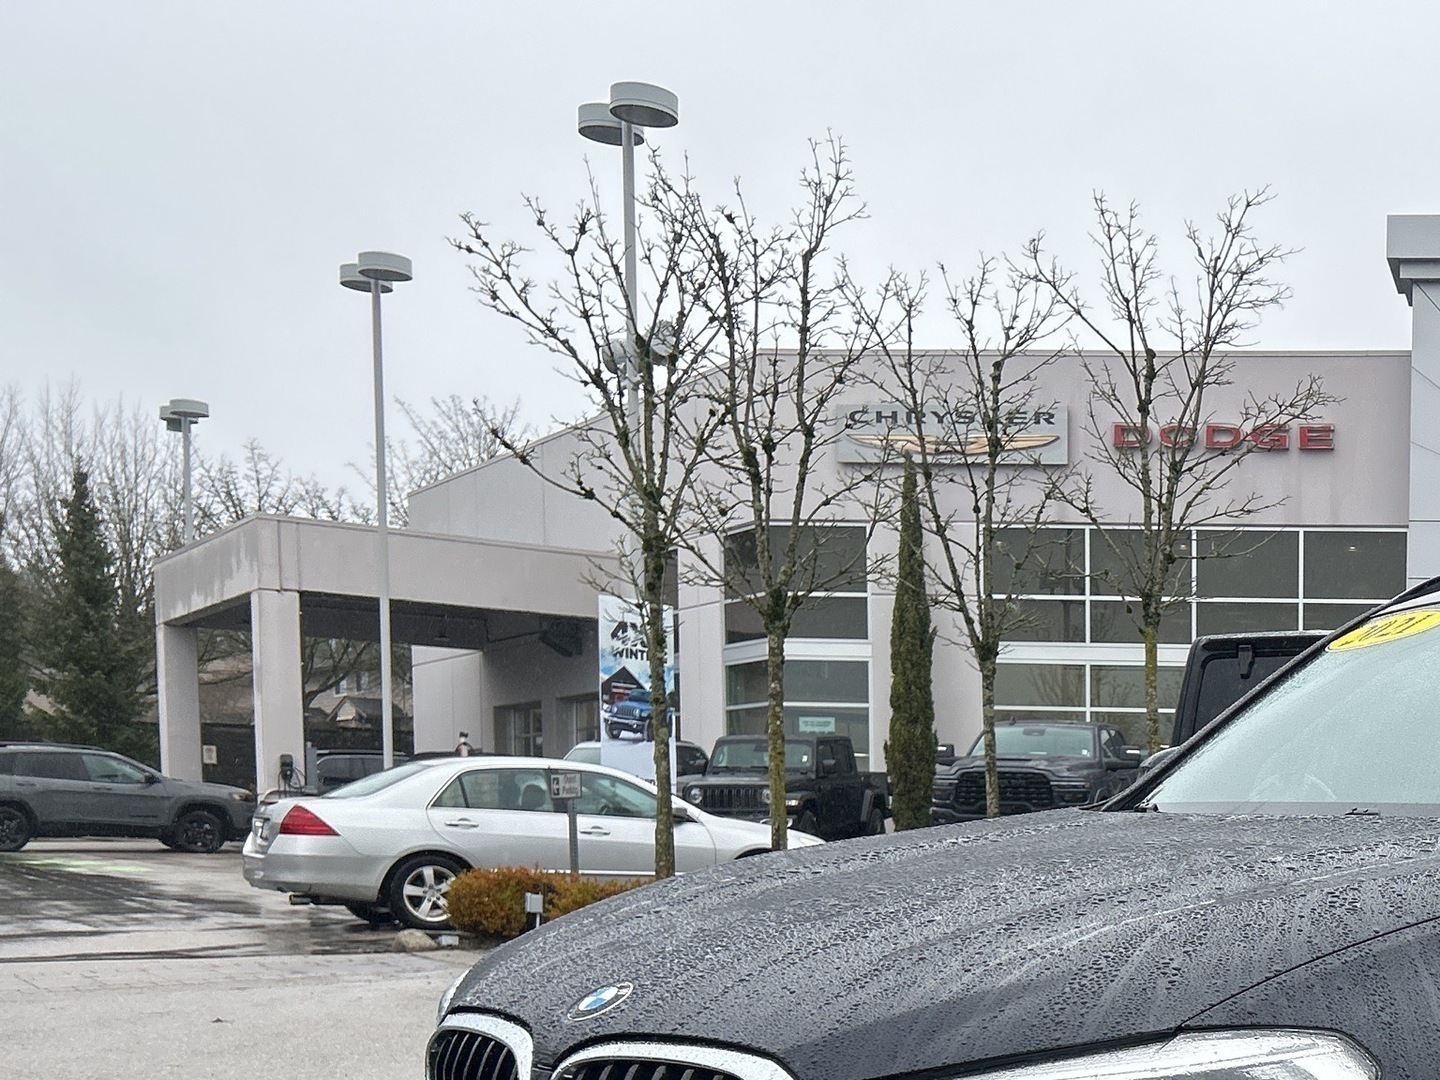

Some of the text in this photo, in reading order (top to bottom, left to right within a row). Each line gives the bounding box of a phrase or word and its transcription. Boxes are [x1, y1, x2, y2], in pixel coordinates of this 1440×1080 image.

[850, 409, 1056, 426] CHRYSER
[1112, 422, 1335, 450] DODGE
[612, 647, 668, 665] WINT
